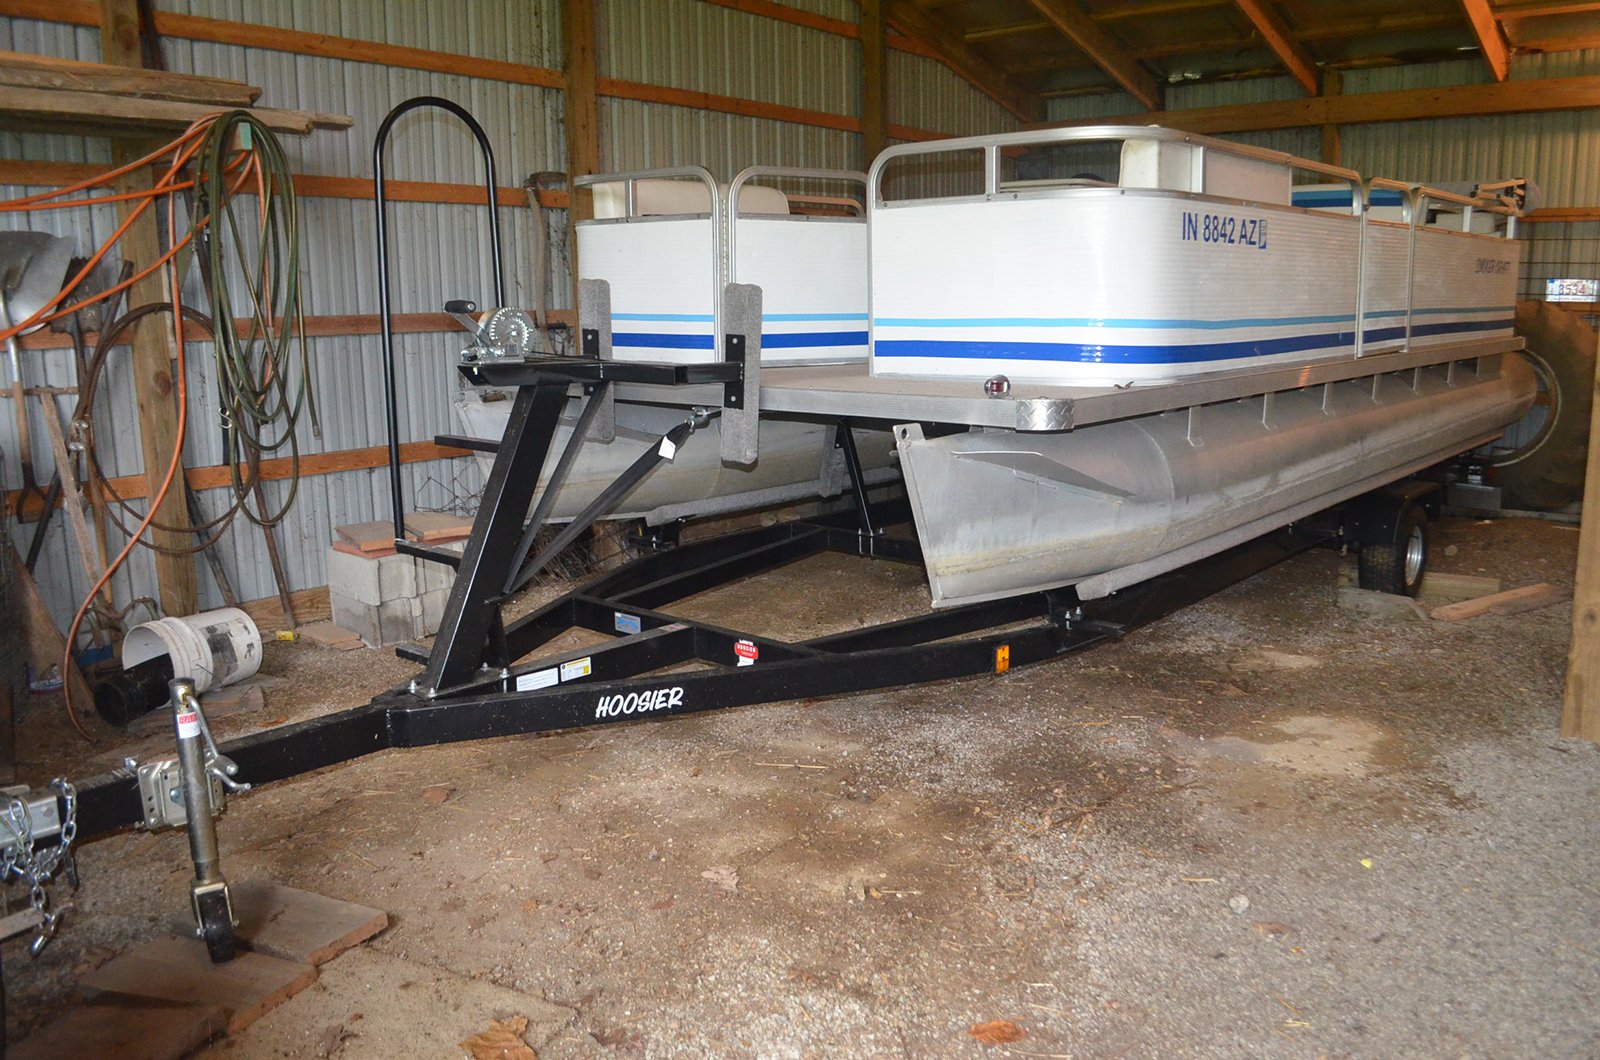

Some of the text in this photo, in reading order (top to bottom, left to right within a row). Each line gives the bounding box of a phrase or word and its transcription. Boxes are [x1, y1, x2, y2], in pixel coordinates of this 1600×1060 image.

[1182, 211, 1198, 241] IN
[1203, 214, 1235, 244] 8842
[1238, 219, 1257, 245] AZ
[595, 687, 684, 718] HOOSIER
